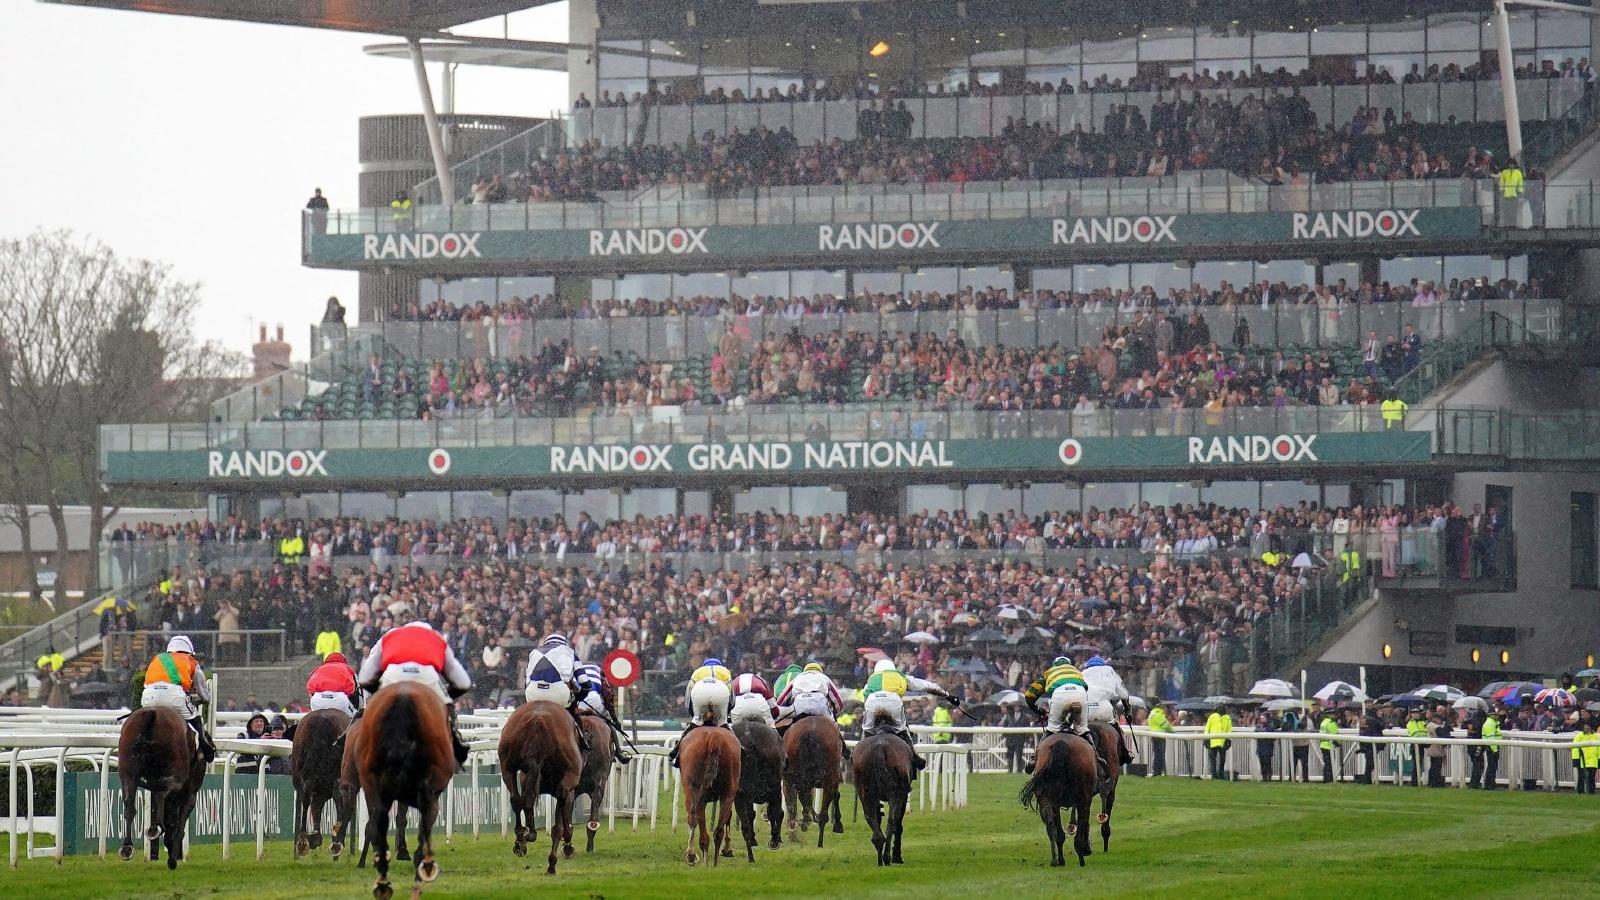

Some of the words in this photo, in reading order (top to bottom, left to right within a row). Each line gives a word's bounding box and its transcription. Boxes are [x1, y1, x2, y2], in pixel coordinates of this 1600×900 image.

[819, 222, 940, 250] RANDOX
[1052, 216, 1177, 244] RANDOX
[1293, 209, 1421, 239] RANDOX
[364, 232, 481, 259] RANDOX
[589, 228, 709, 255] RANDOX
[550, 445, 673, 472] RANDOX
[687, 443, 792, 470] GRAND
[804, 441, 953, 469] NATIONAL
[1188, 434, 1318, 463] RANDOX
[208, 450, 328, 476] RANDOX
[84, 789, 114, 838] RANX
[228, 788, 246, 835] RAND
[247, 788, 280, 834] NAONAL
